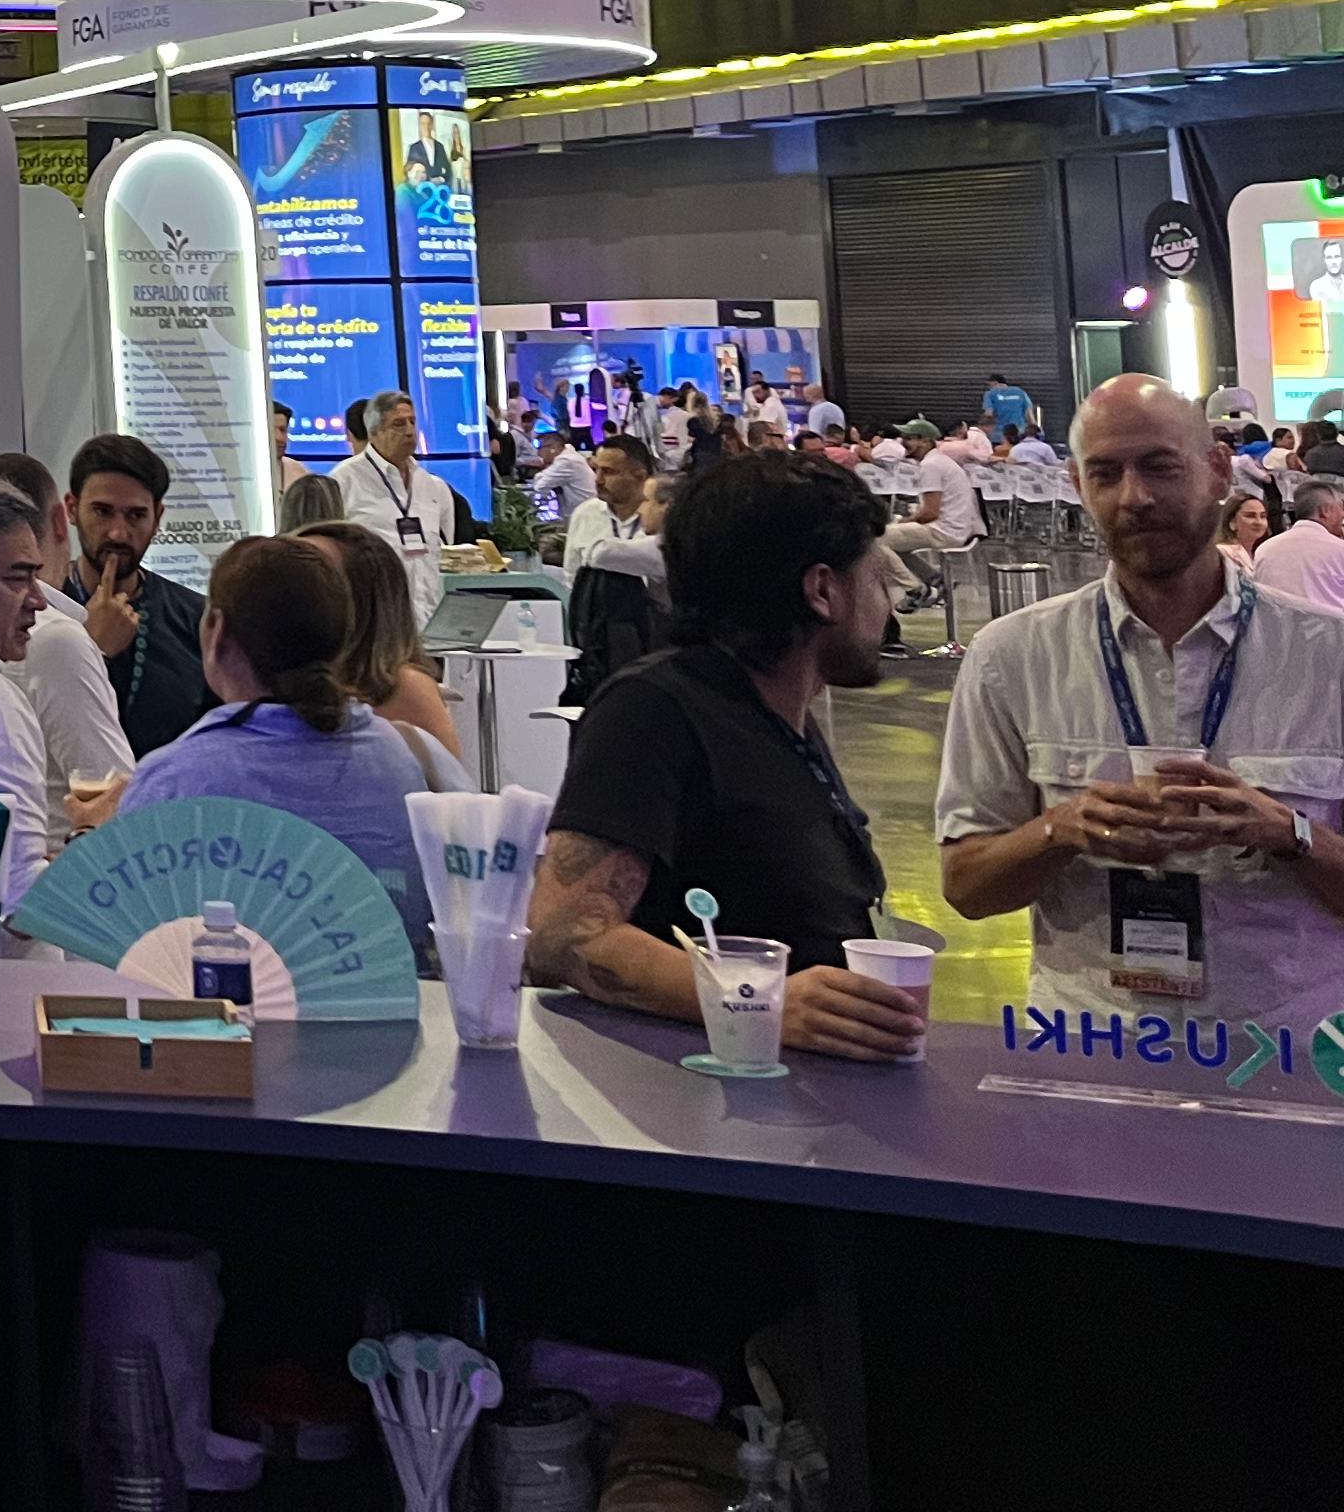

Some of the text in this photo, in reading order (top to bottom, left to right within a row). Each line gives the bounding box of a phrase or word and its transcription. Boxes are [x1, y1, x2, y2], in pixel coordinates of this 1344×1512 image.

[158, 4, 169, 16] DE
[72, 13, 105, 46] FGA
[416, 181, 451, 225] 28
[133, 285, 190, 302] RESPALDO
[129, 306, 236, 318] NUESTRA PROPUESTA
[159, 318, 208, 329] DE VALOR
[317, 318, 379, 334] crédito
[206, 520, 220, 531] DE
[152, 532, 199, 545] EGOCIOS
